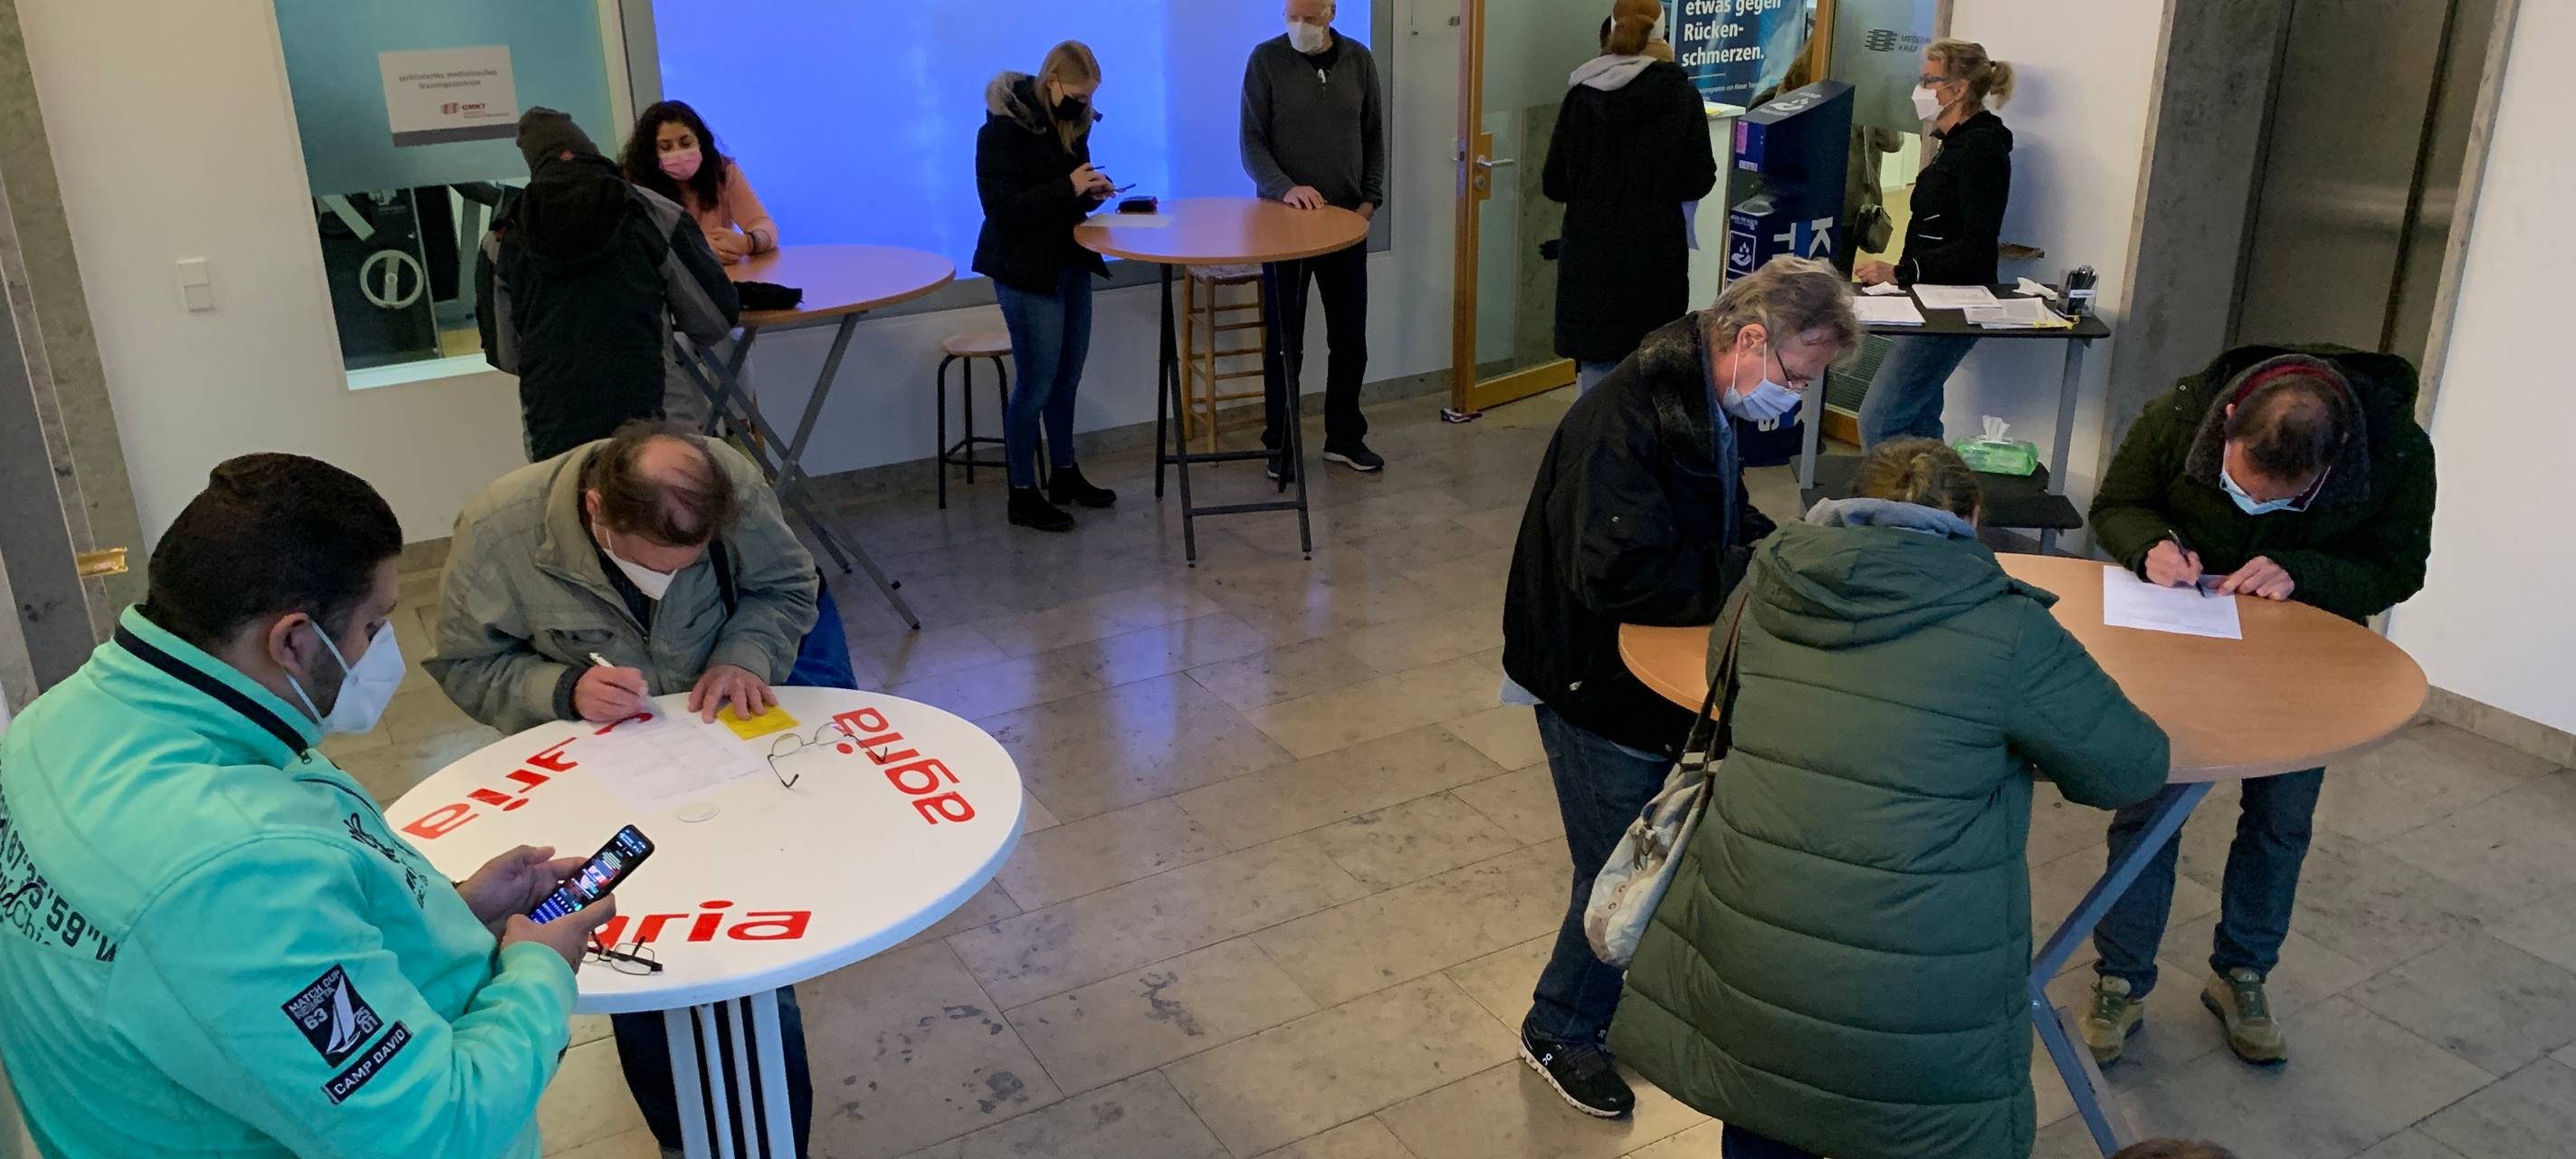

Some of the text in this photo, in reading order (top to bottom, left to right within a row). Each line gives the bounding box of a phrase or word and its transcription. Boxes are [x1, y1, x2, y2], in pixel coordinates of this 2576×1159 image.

[1685, 0, 1781, 16] etwas gegen
[1684, 21, 1743, 42] Rücken-
[1682, 46, 1765, 67] schmerzen.
[832, 707, 976, 825] agria
[288, 969, 340, 1013] MATCH CUP
[303, 1007, 328, 1030] 63
[362, 1019, 378, 1034] 01
[333, 1029, 405, 1095] CAMP DAVID
